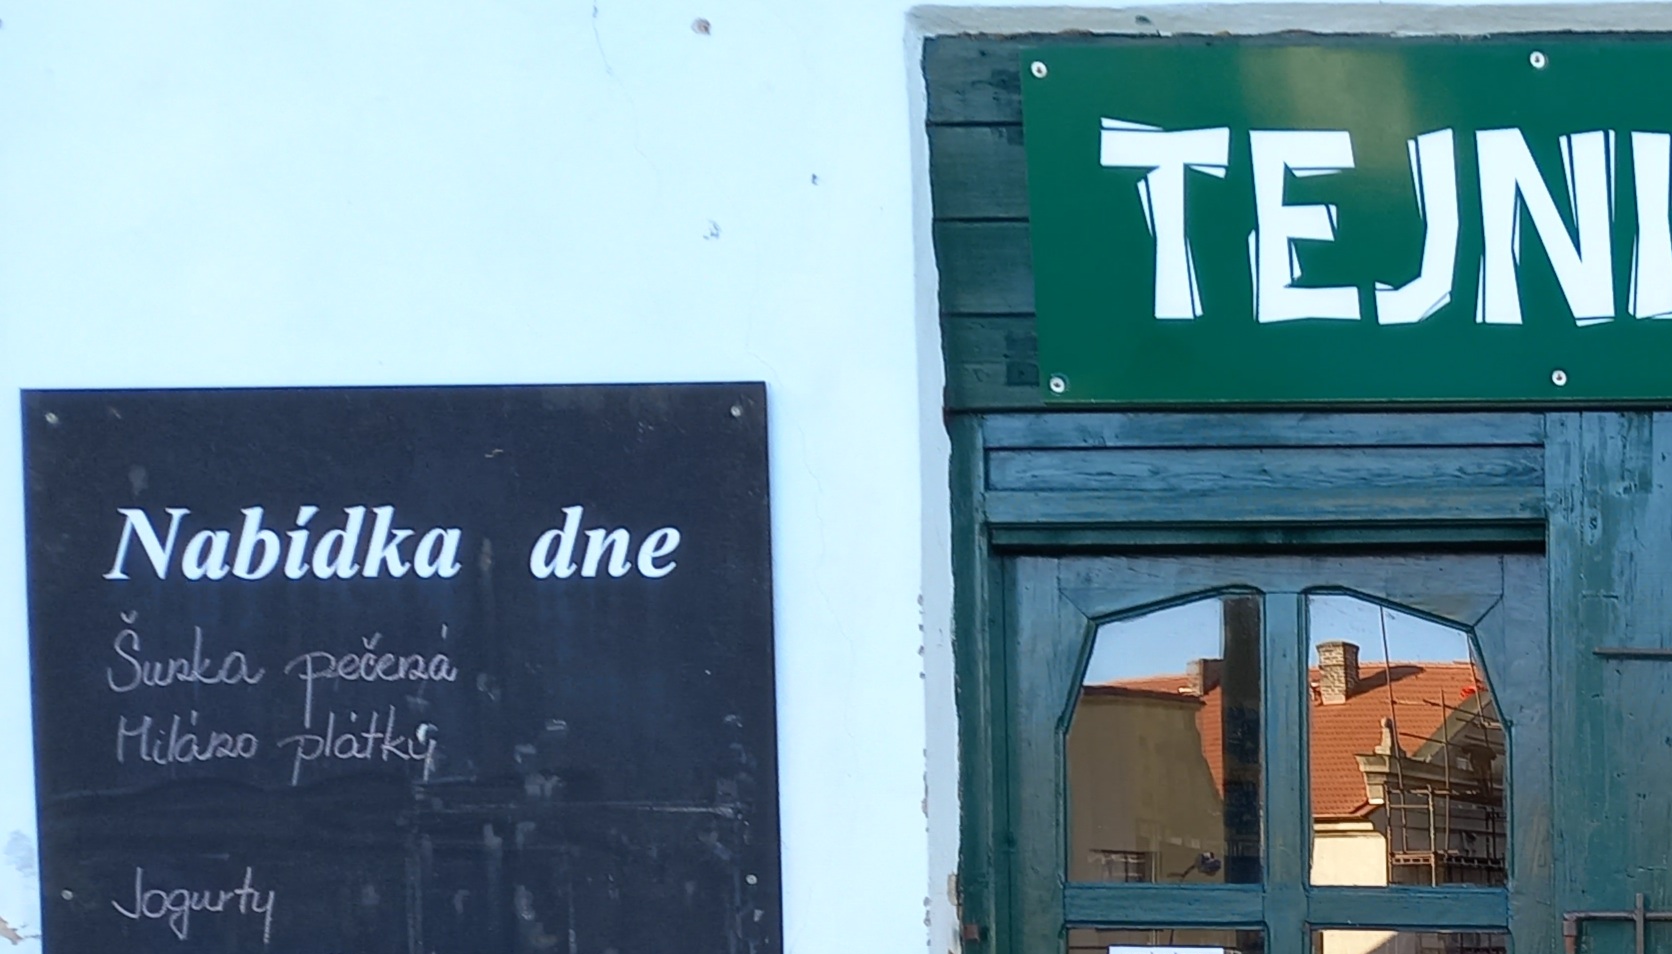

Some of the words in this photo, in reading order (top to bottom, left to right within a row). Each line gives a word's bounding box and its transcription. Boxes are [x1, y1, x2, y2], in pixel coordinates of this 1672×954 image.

[103, 505, 463, 580] Nabídka
[529, 505, 681, 580] dne
[107, 611, 264, 693] Šunka
[286, 624, 459, 727] pečená
[112, 867, 276, 943] Jogurty
